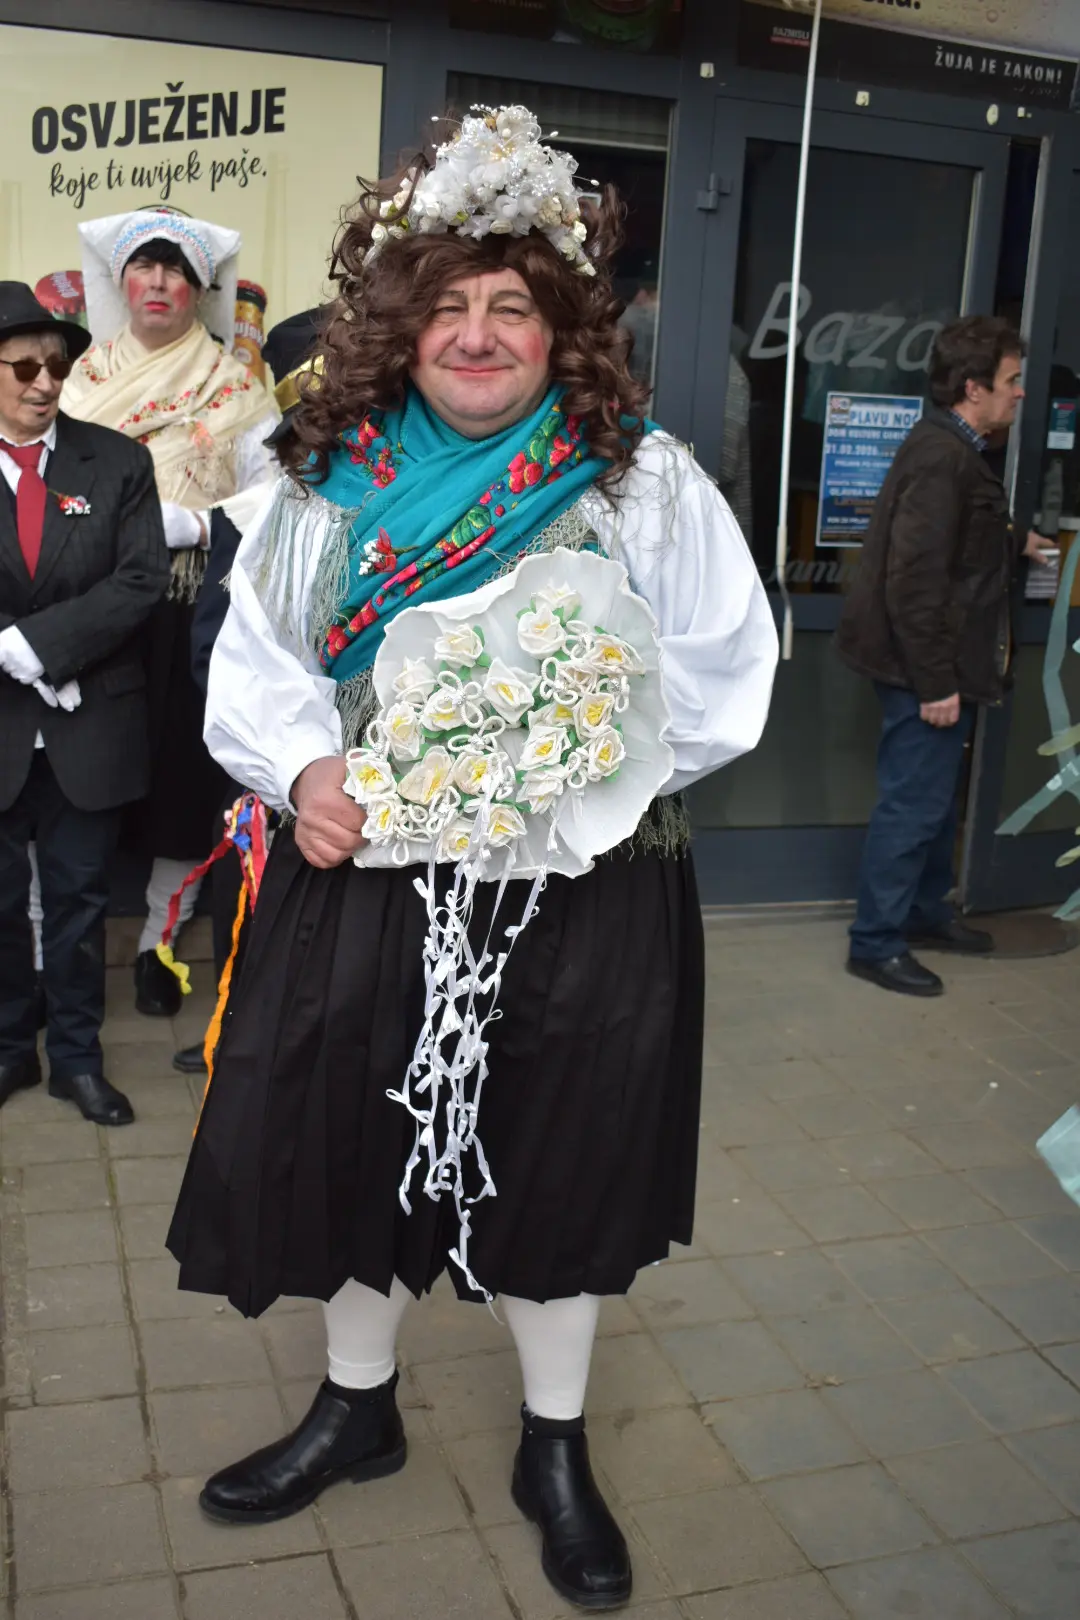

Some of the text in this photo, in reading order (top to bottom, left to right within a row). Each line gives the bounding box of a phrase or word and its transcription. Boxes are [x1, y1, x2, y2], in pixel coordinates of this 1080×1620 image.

[934, 45, 1063, 84] ŽUJA JE ZAKON!
[31, 81, 286, 154] OSVJEŽENJE
[48, 148, 267, 209] koje ti uvijek paše.
[849, 410, 890, 425] PLAVU
